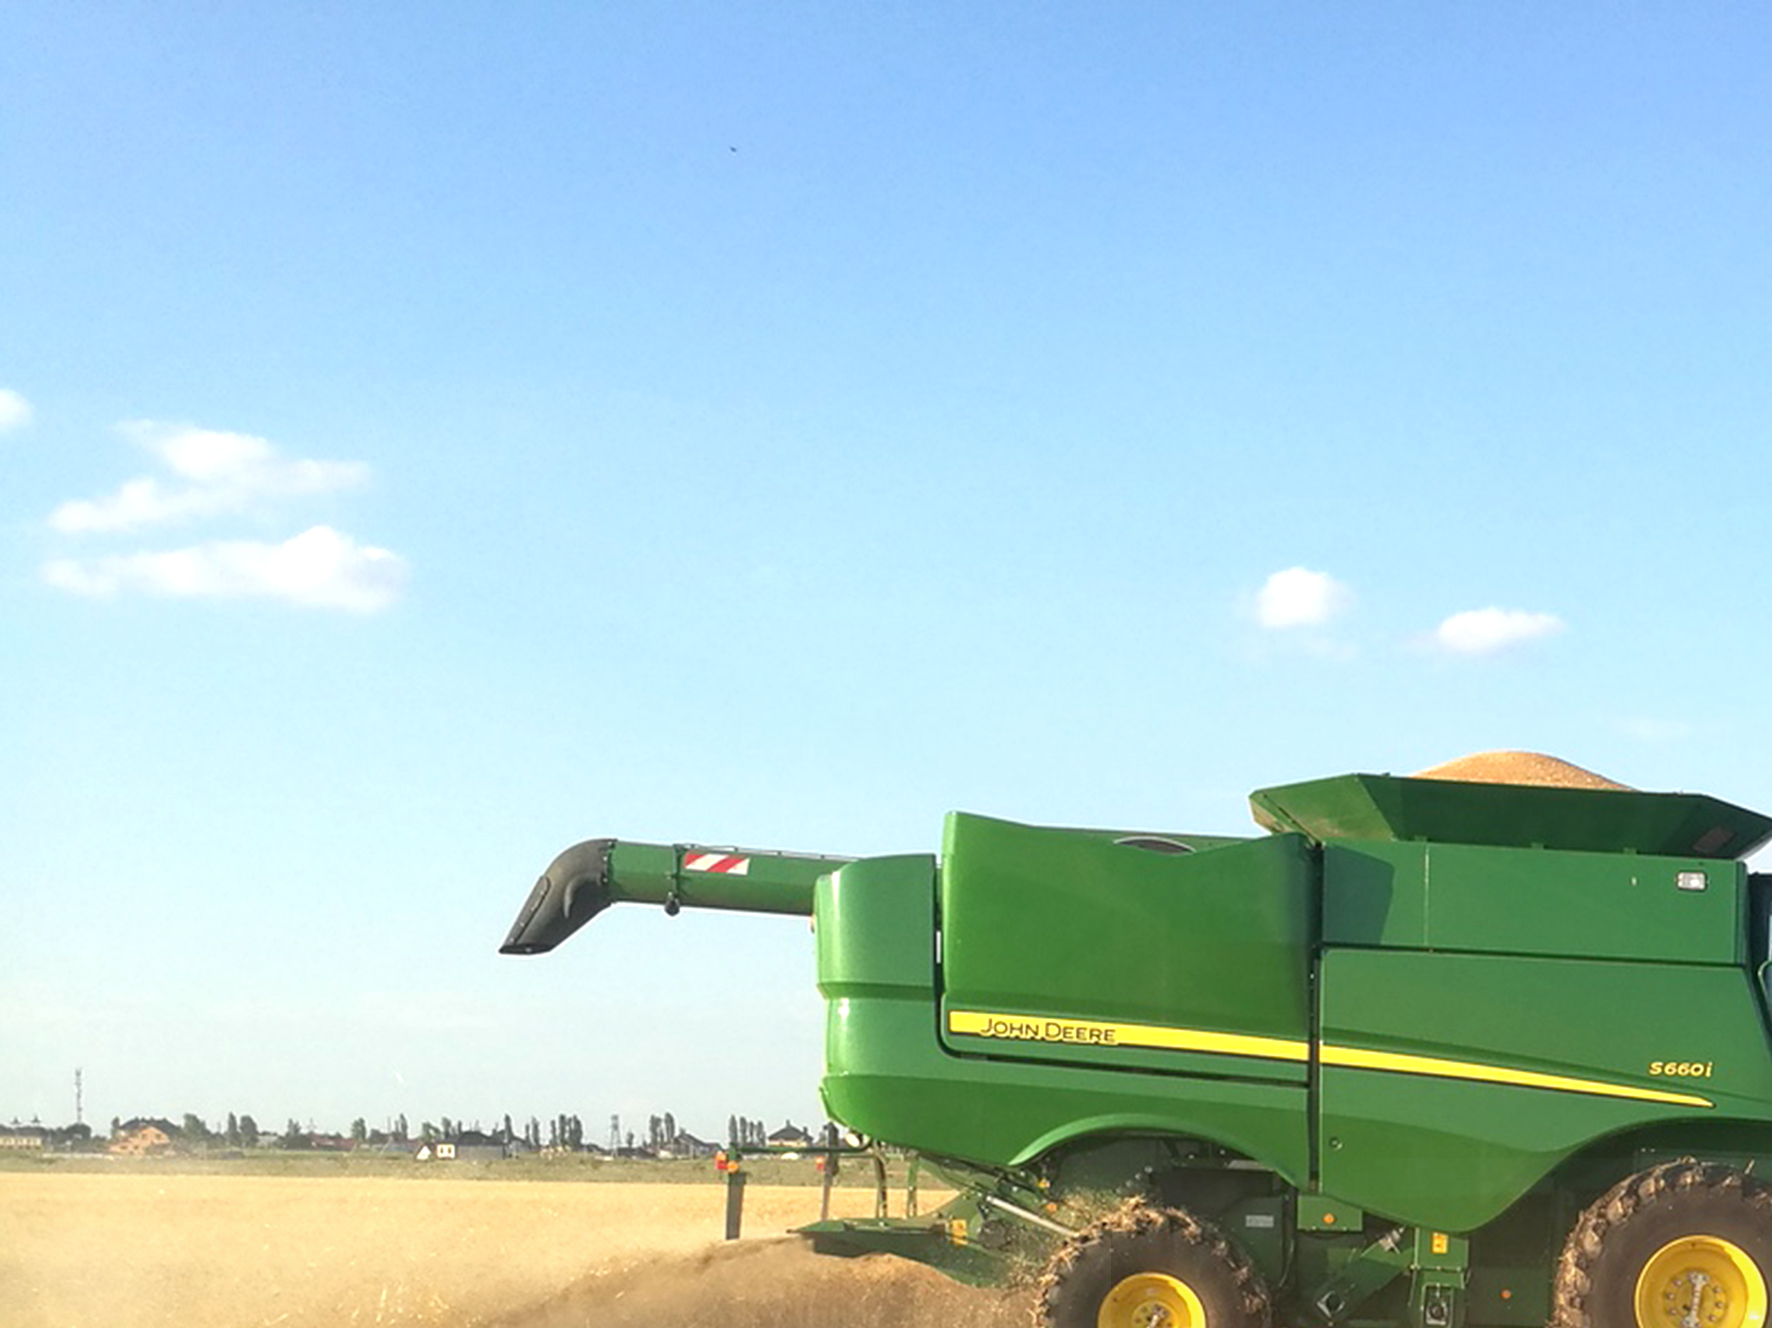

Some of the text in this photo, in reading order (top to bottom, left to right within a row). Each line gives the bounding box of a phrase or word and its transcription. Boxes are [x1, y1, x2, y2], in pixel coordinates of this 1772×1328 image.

[981, 1017, 1117, 1043] JOHN DEERE
[1649, 1061, 1713, 1078] S660i
